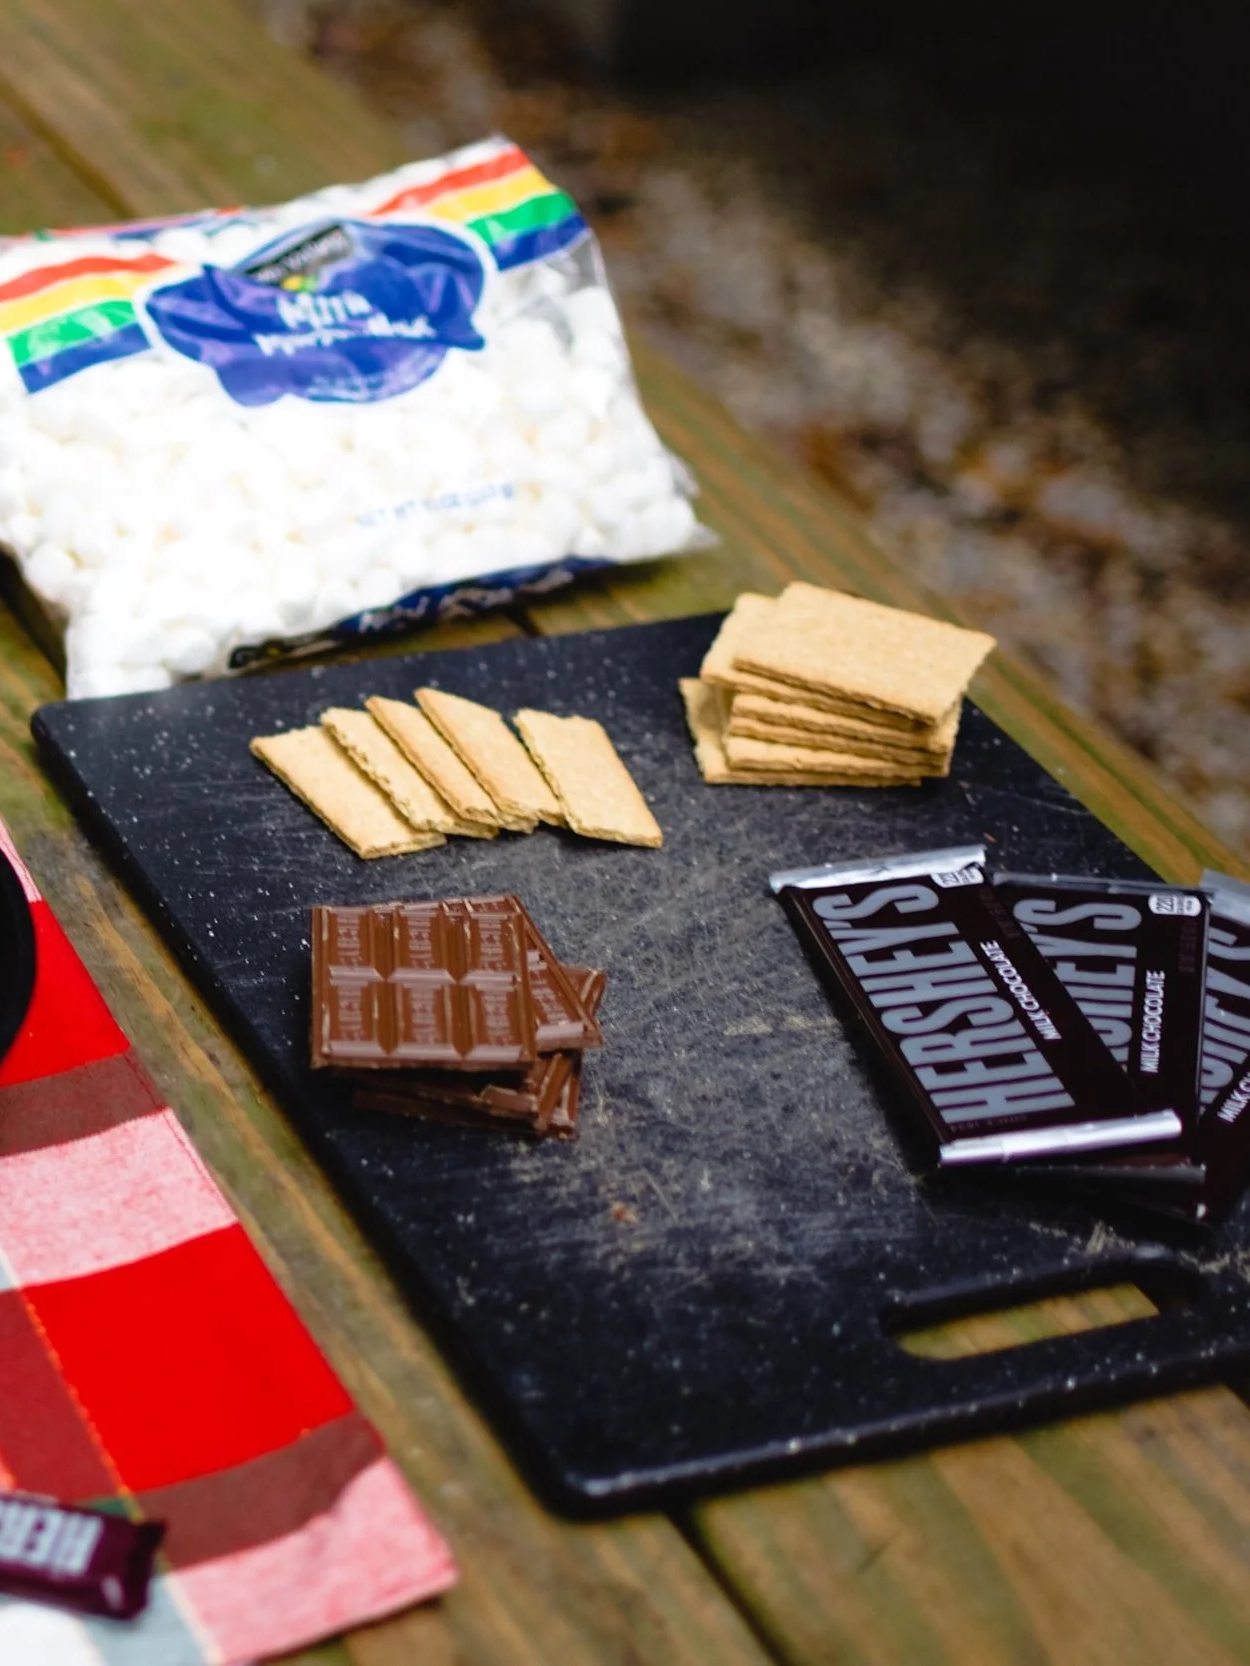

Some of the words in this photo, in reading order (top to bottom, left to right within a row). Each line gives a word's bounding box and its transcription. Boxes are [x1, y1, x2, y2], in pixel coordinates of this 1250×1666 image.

[980, 940, 1040, 1012] CHOCOLATE
[811, 884, 1076, 1124] HERSHEY'S
[1027, 1009, 1062, 1040] MILK
[1142, 970, 1165, 1041] CHOCOLATE
[1140, 1041, 1160, 1073] MILK
[1217, 1089, 1249, 1122] MILK
